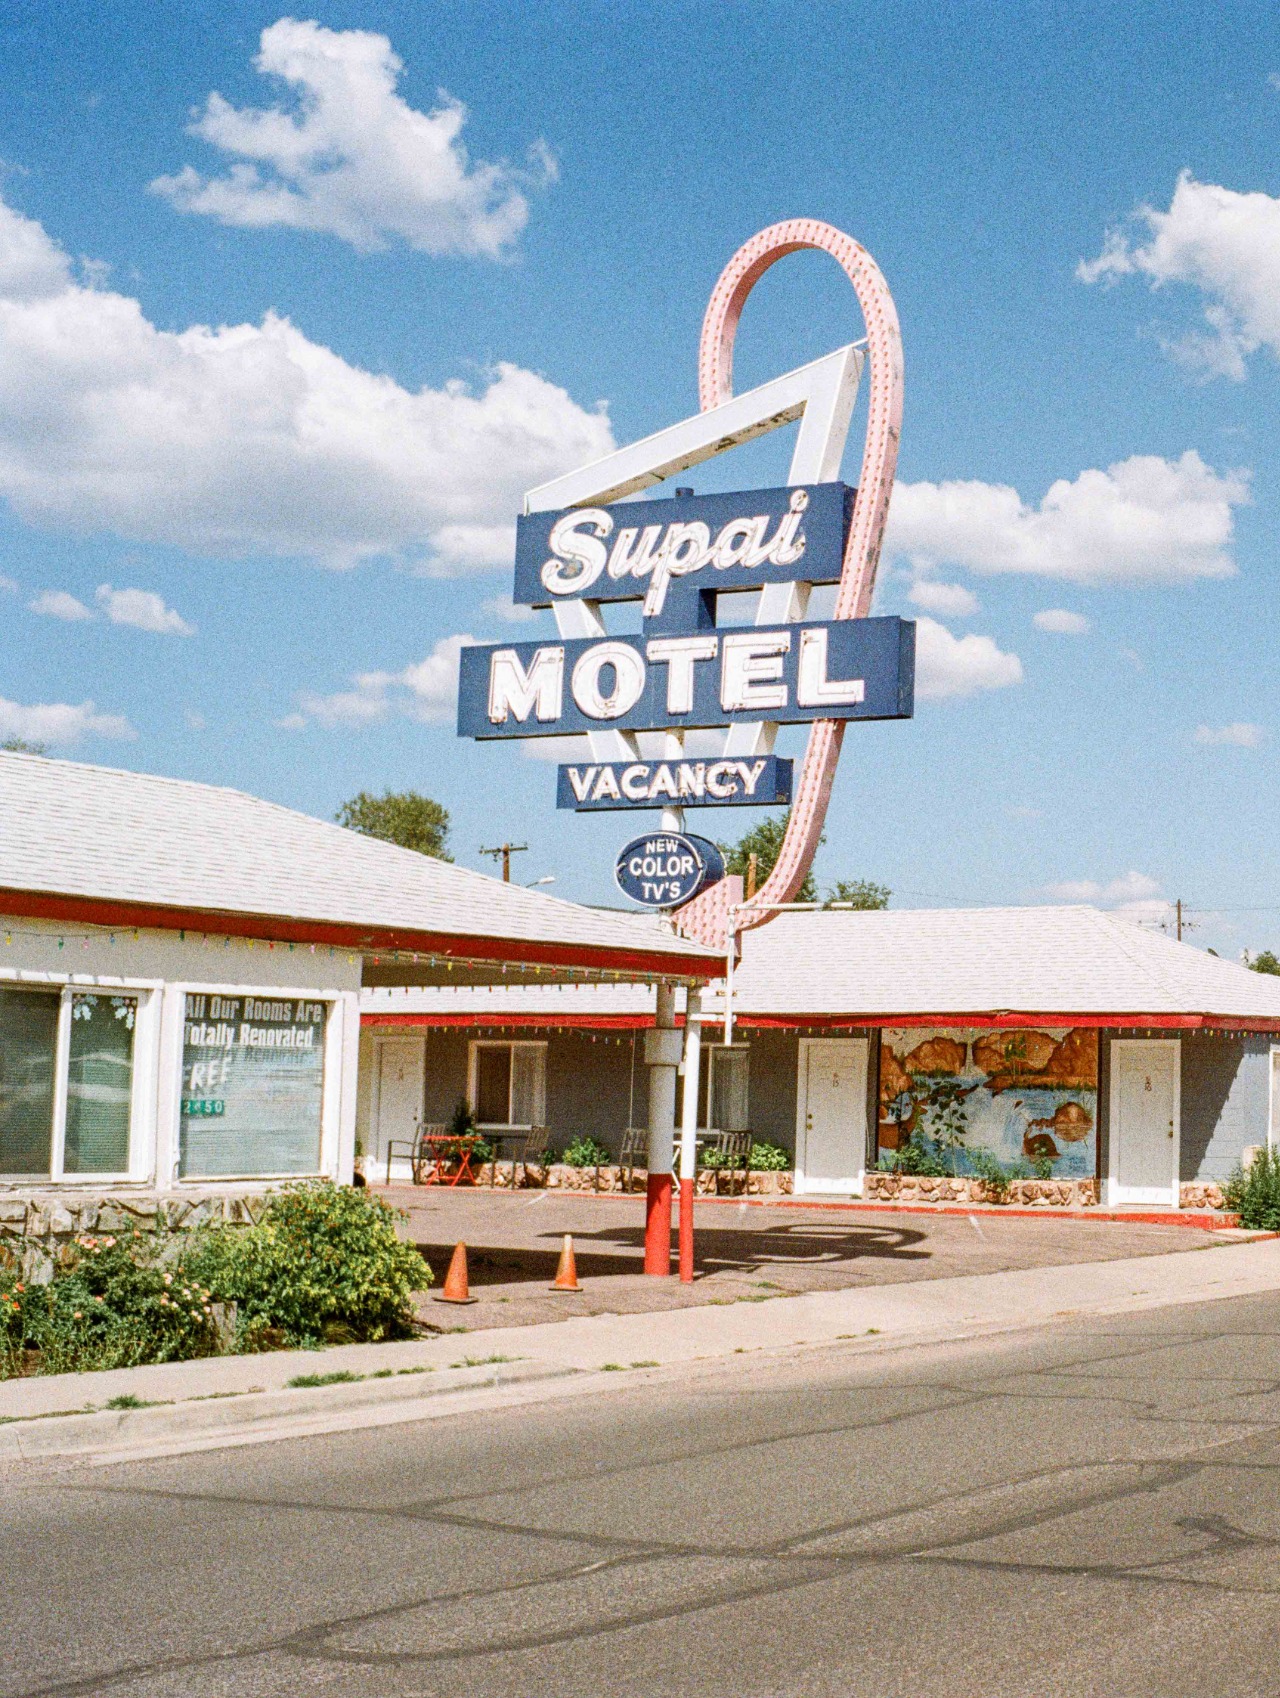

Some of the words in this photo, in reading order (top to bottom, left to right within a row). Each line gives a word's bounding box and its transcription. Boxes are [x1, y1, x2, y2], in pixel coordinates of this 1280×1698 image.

[541, 490, 808, 615] Supai
[487, 629, 864, 723] MOTEL
[568, 760, 766, 799] VACANCY
[646, 839, 680, 854] NEW
[629, 856, 694, 877] COLOR
[641, 881, 681, 900] TV'S
[185, 995, 206, 1018] All
[210, 996, 240, 1019] Our
[243, 997, 292, 1021] Rooms
[295, 1000, 322, 1022] Are
[184, 1021, 235, 1050] Totally
[240, 1023, 314, 1047] Renovated
